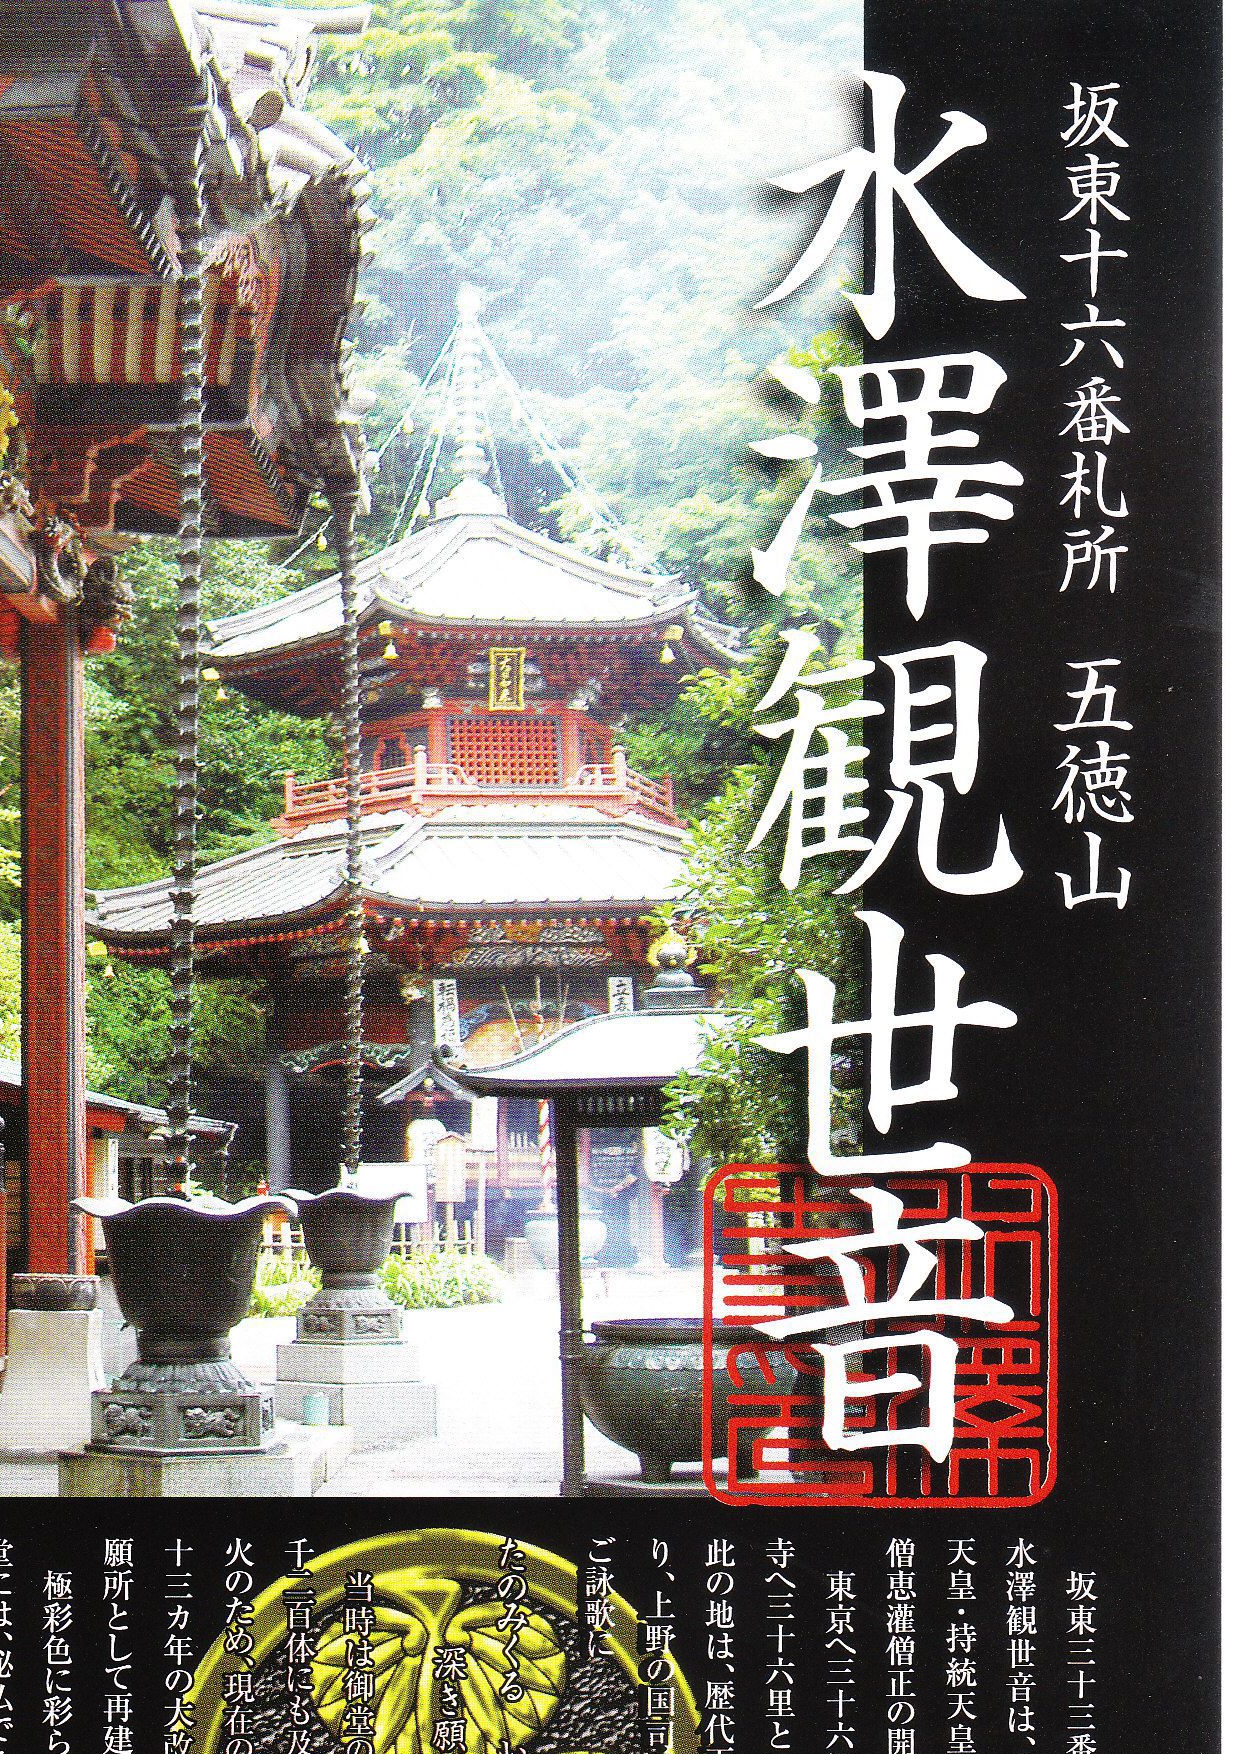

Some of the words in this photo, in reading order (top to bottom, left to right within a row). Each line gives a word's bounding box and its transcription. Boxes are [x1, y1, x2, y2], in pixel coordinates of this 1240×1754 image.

[1059, 82, 1130, 593] 坂東十六番札所
[746, 70, 1027, 1464] 水澤観世音
[1052, 658, 1134, 909] 五徳山
[497, 1538, 529, 1701] たのみくる
[584, 1538, 615, 1657] ご詠歌に
